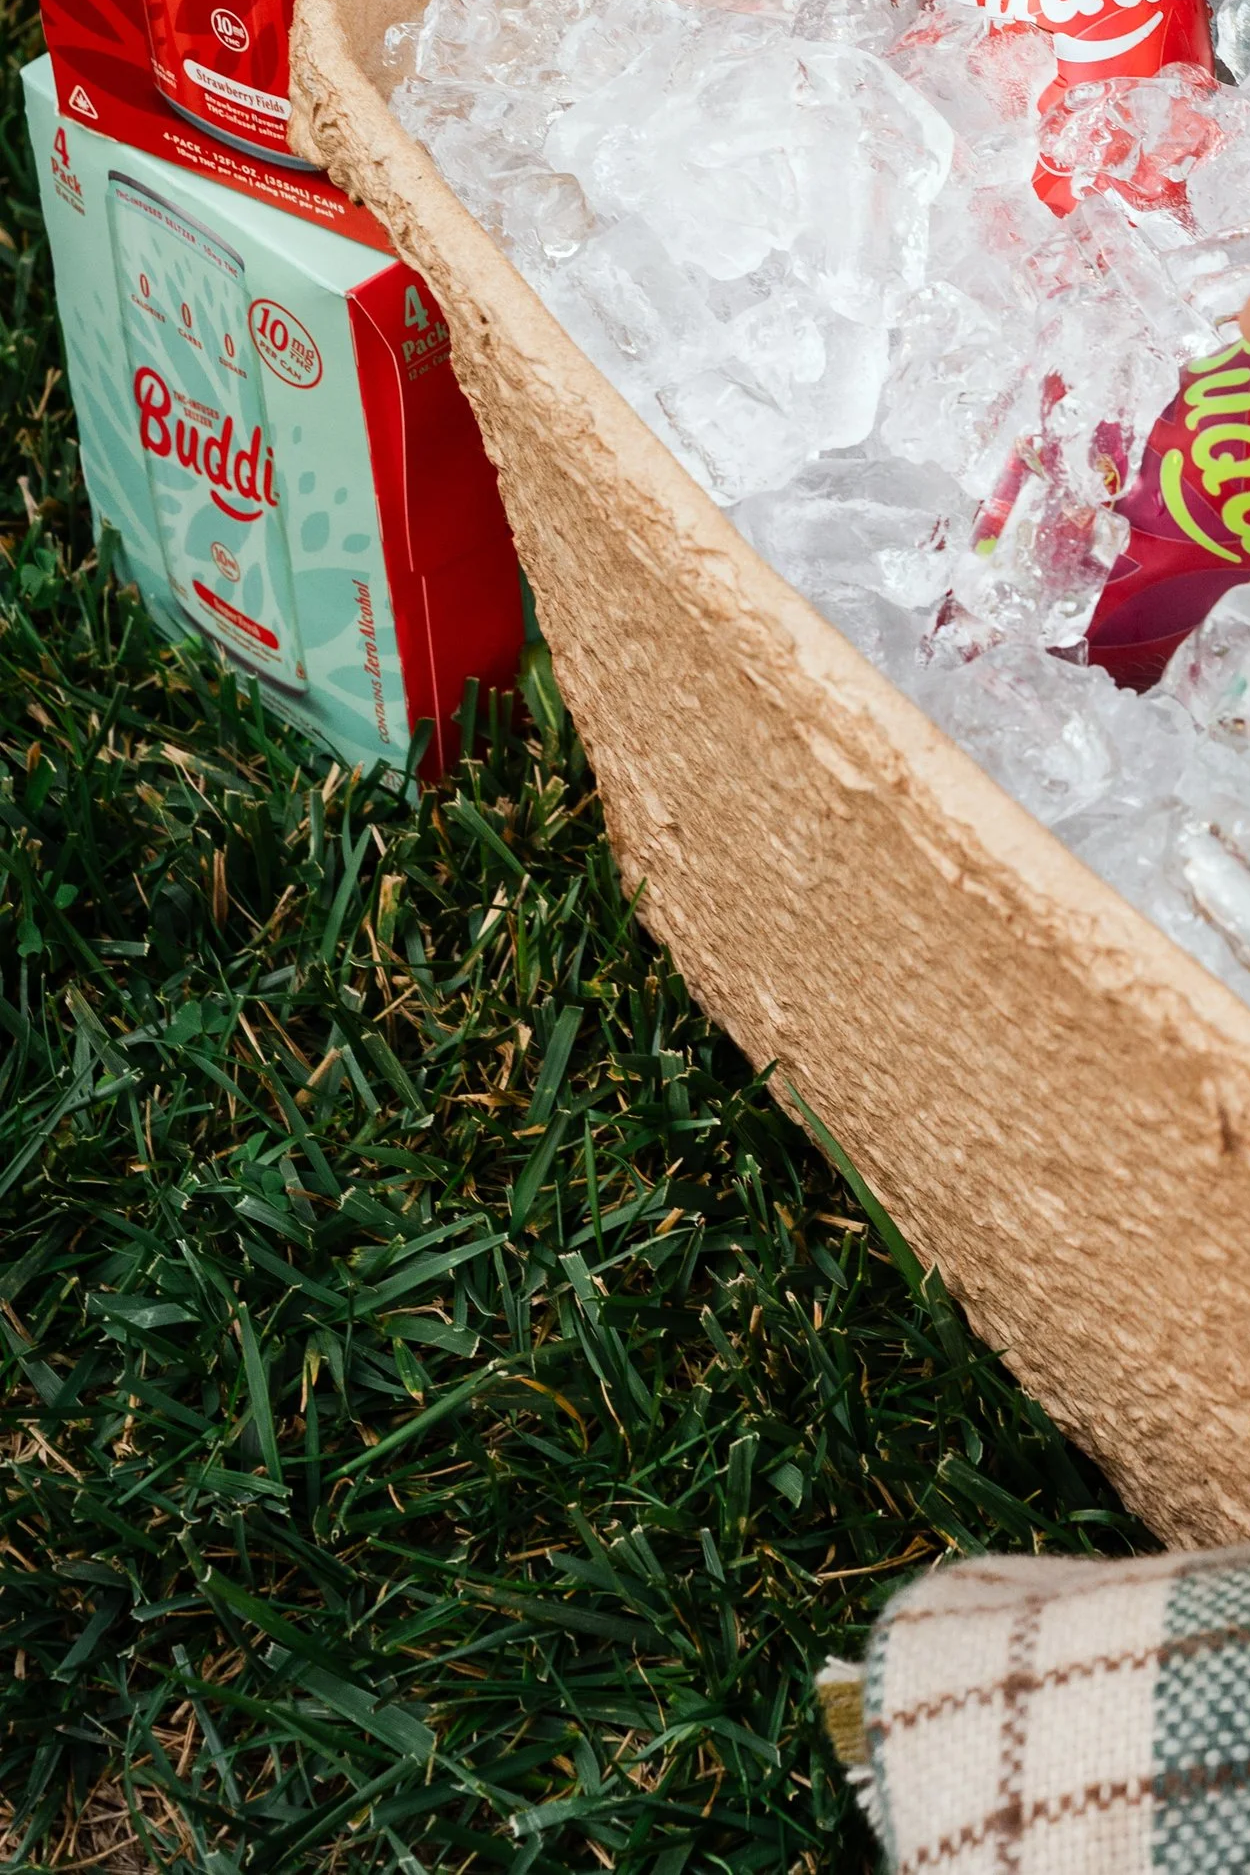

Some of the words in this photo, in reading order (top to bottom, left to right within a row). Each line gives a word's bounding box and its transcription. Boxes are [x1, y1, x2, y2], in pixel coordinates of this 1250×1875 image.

[195, 68, 254, 107] Strawberry
[256, 94, 286, 115] Fields
[53, 126, 70, 170] 4
[51, 156, 82, 198] Pack
[163, 132, 202, 155] 4-PACK
[313, 193, 345, 215] CANS
[115, 188, 163, 221] THC-INFUSED
[164, 215, 197, 244] SELTZER
[140, 273, 150, 298] 0
[131, 293, 165, 323] CALORIES
[182, 303, 192, 329] 0
[405, 285, 430, 332] 4
[177, 327, 203, 350] CARBS
[224, 333, 235, 358] 0
[256, 307, 289, 352] 10
[401, 322, 449, 363] Pack
[218, 356, 248, 379] SUGARS
[258, 340, 280, 362] PER
[280, 357, 302, 380] CAN
[289, 351, 312, 373] THC
[134, 366, 278, 522] Buddi
[352, 578, 377, 642] Alcohol
[363, 639, 382, 679] Zero
[370, 680, 391, 746] CONTAINS
